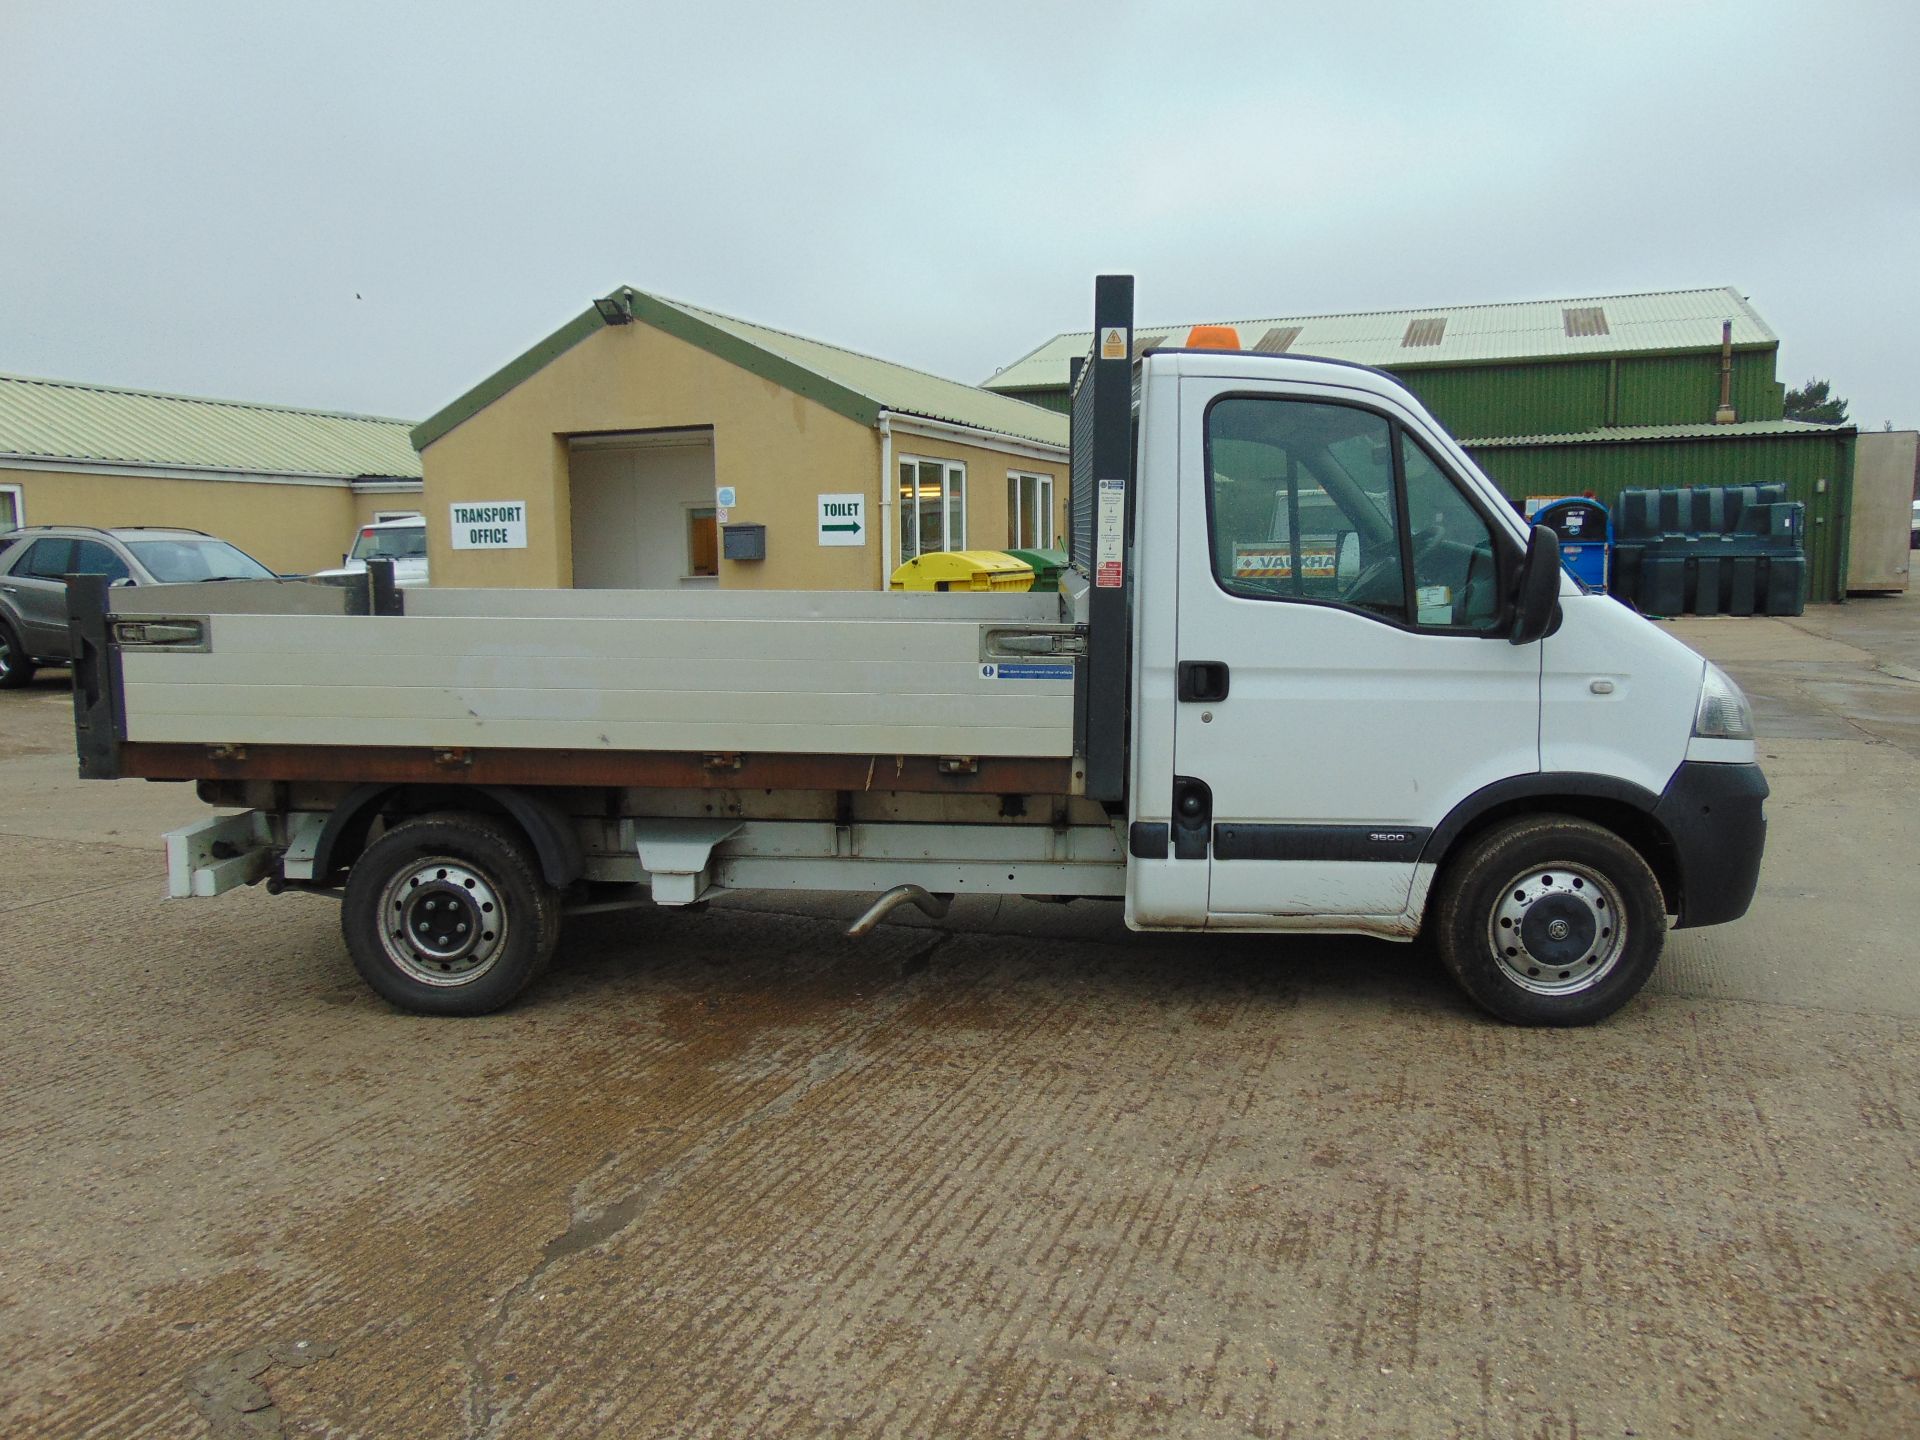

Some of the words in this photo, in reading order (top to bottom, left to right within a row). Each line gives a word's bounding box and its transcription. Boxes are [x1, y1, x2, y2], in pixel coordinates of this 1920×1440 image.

[454, 507, 522, 523] TRANSPORT
[823, 503, 860, 516] TOILET
[470, 528, 508, 544] OFFICE
[1370, 833, 1405, 841] 3500
